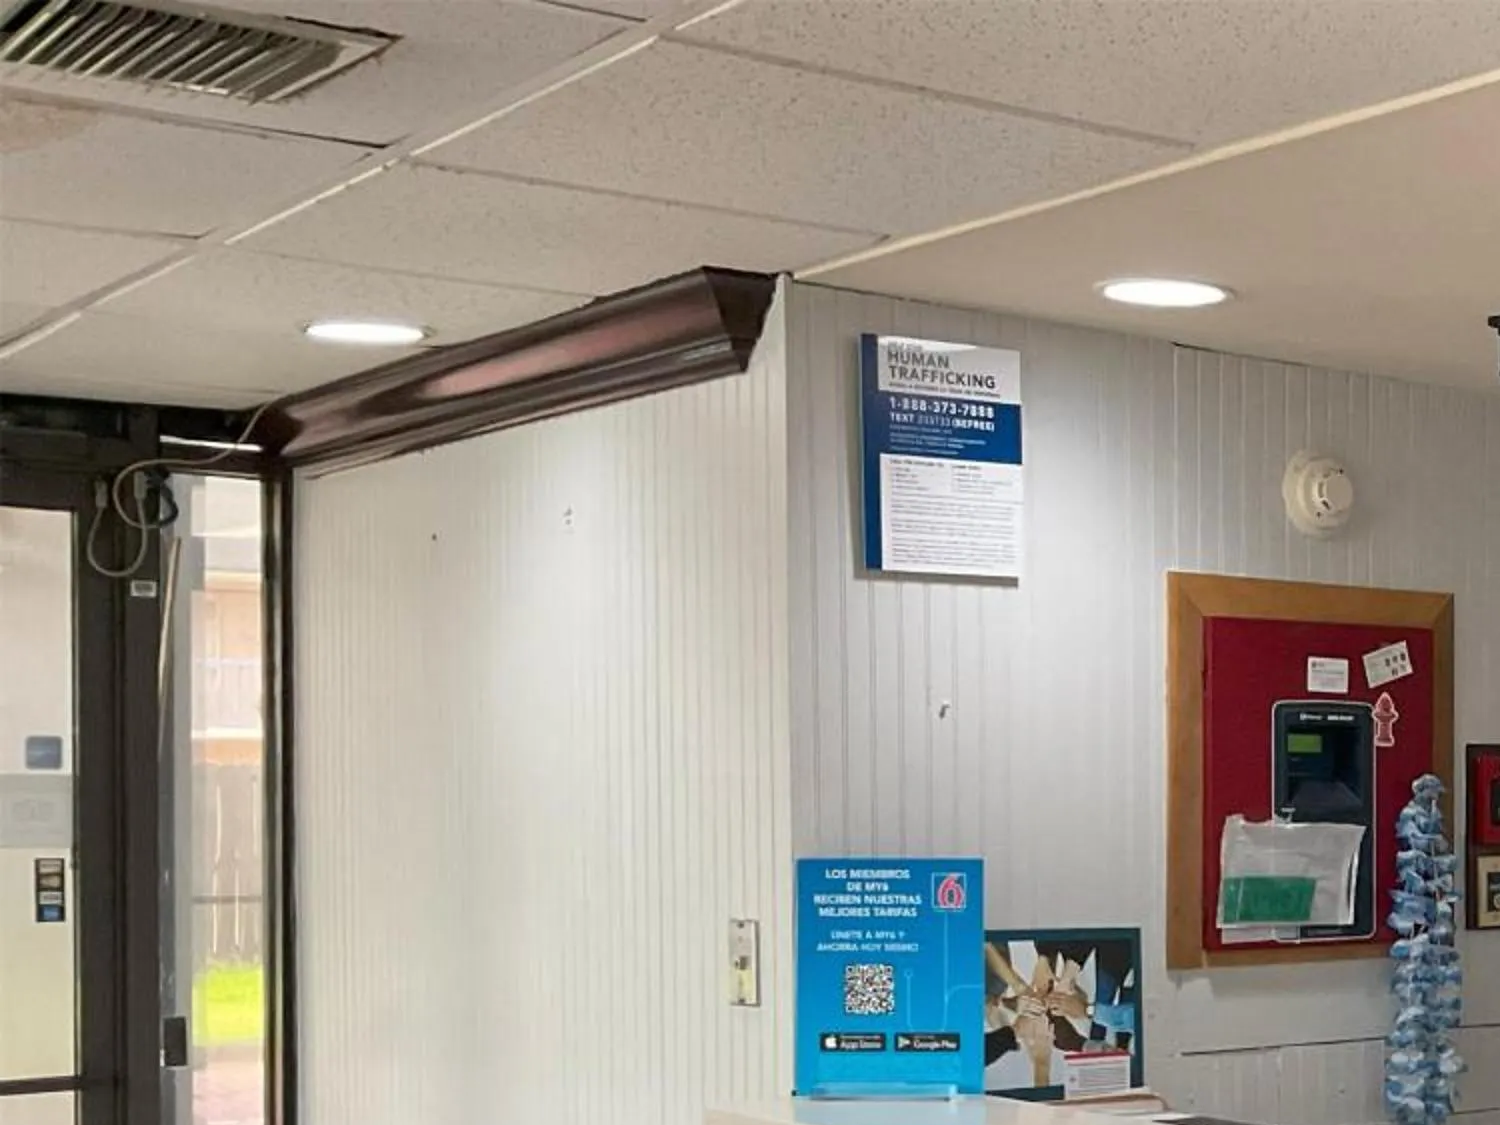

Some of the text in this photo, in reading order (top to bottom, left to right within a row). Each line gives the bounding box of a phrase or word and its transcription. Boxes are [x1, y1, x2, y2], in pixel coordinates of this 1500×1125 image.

[887, 350, 950, 369] HUMAN
[888, 365, 996, 389] TRAFFICKING
[889, 396, 995, 419] 1-888-373-7888
[889, 412, 915, 424] TEXT
[825, 868, 847, 879] LOS
[846, 881, 863, 892] DE
[863, 894, 922, 905] NUESTRAS
[818, 907, 918, 918] MEJORES TARIFAS
